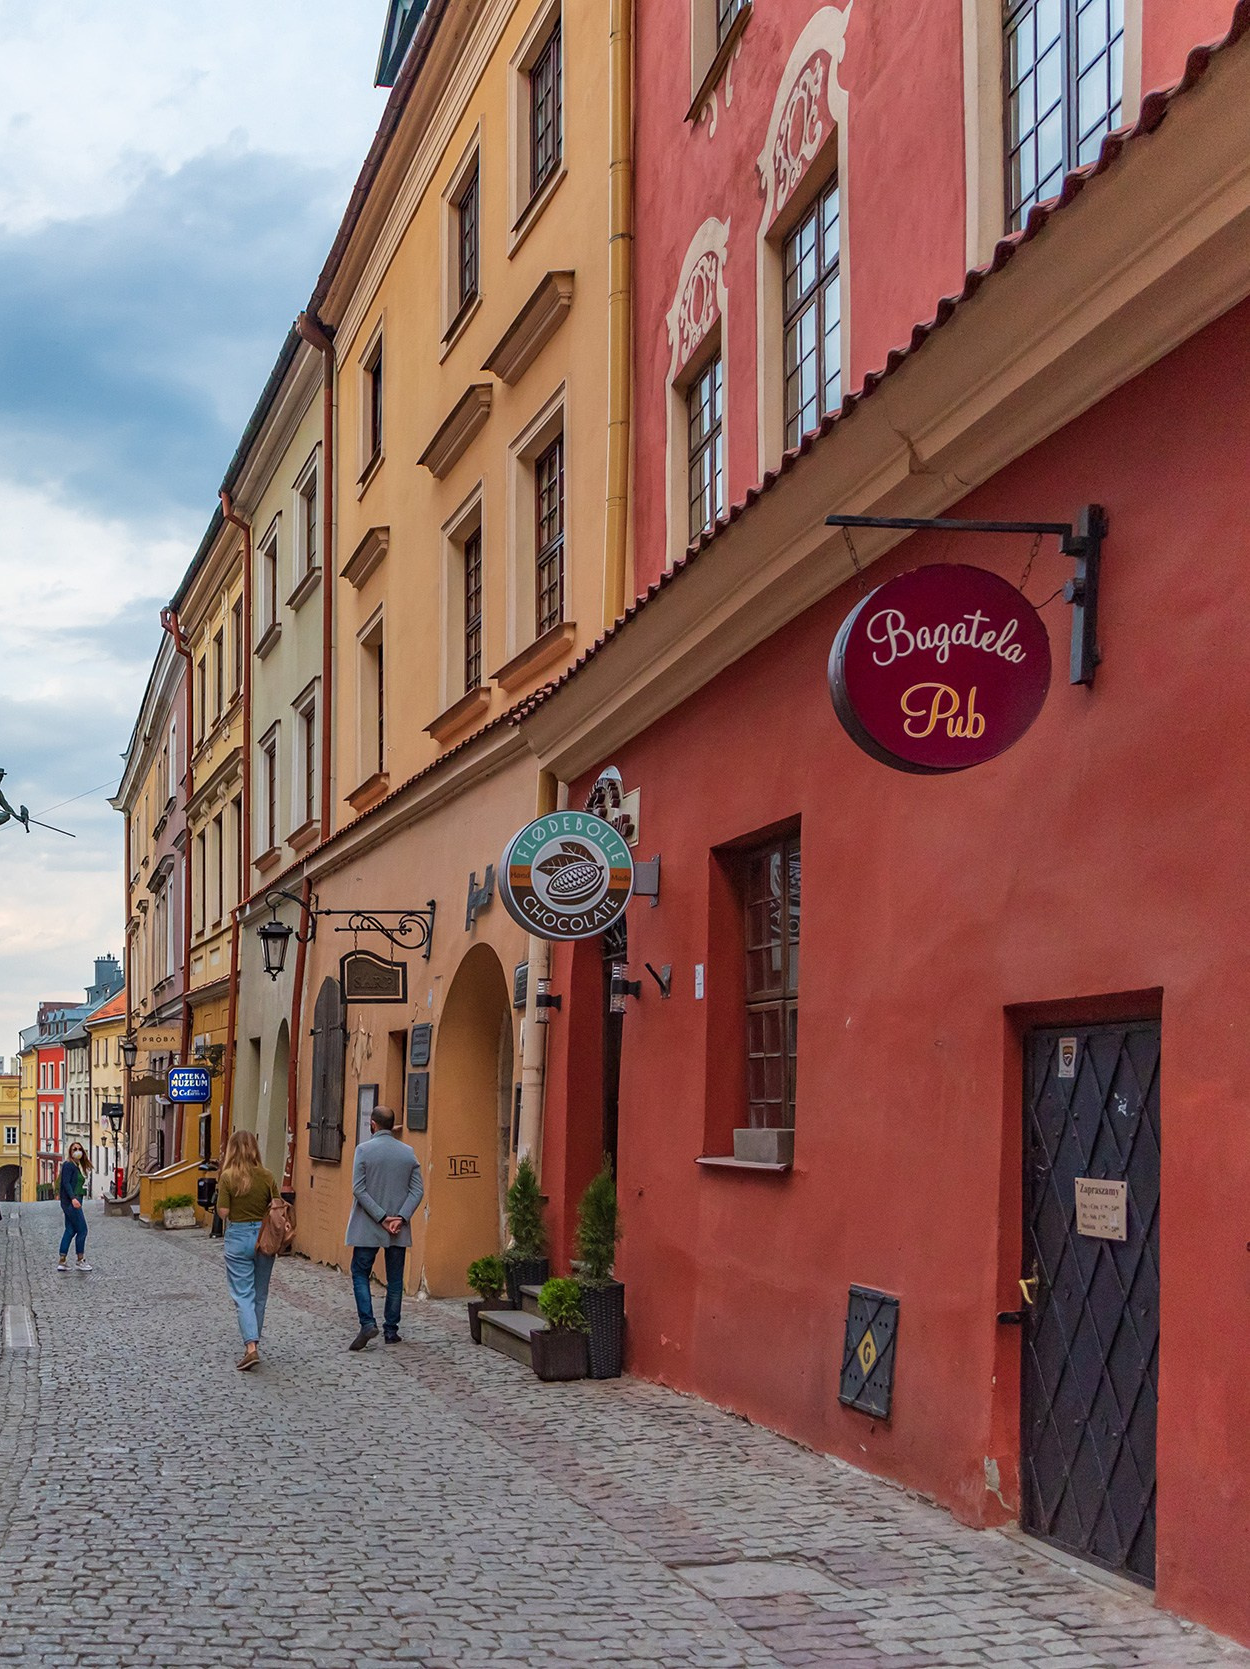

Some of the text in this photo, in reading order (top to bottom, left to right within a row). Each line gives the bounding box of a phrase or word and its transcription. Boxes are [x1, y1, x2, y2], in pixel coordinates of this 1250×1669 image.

[866, 609, 1027, 667] Bagatela
[900, 682, 986, 739] Pub
[516, 816, 625, 862] FLØDEBOLLE
[523, 896, 619, 931] CHOCOLATE
[171, 1079, 208, 1087] MUZEUM
[1079, 1183, 1120, 1199] Zapraszamy
[863, 1341, 871, 1365] G
